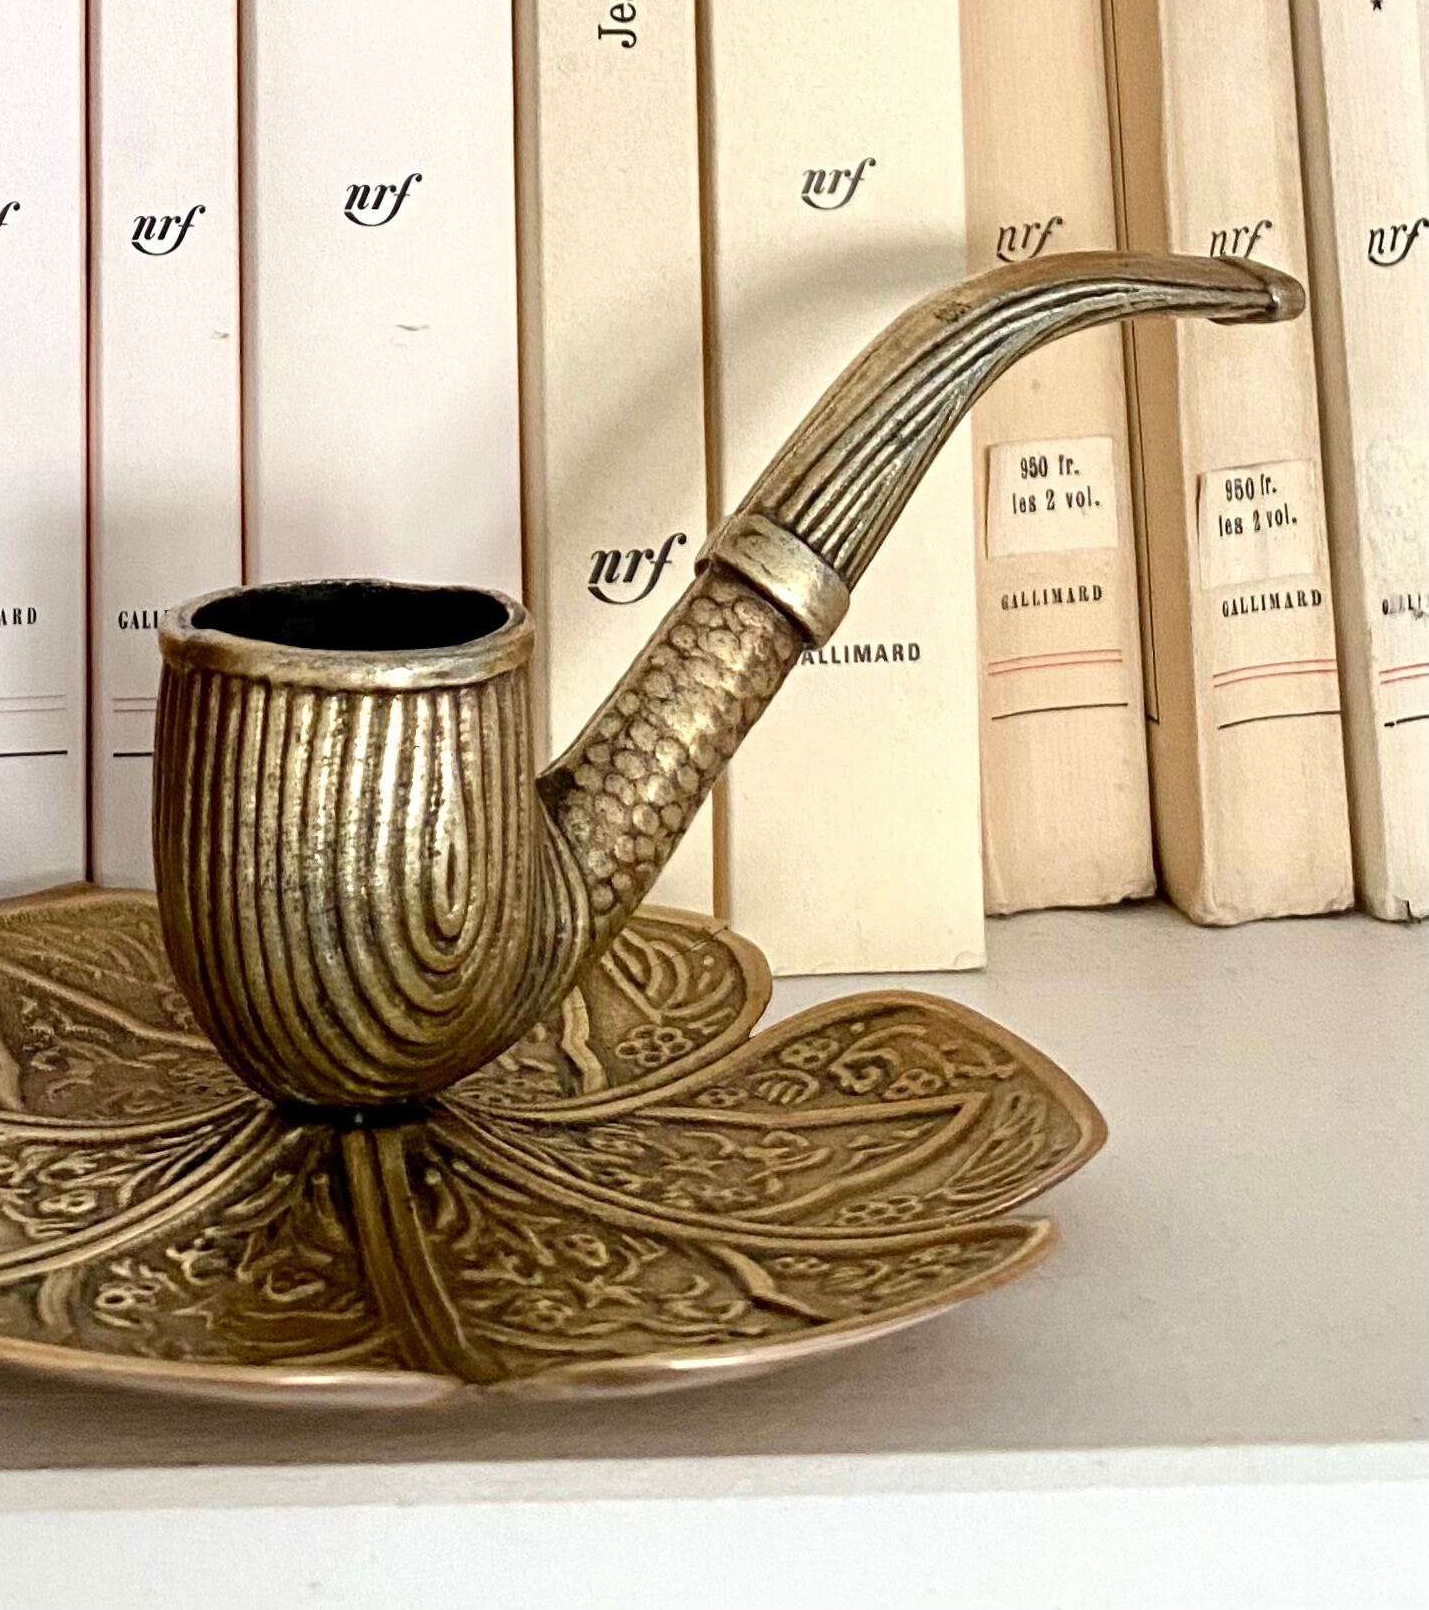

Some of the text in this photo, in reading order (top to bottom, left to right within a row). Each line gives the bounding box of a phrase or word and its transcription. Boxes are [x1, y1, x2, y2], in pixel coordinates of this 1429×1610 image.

[341, 171, 424, 228] nrf
[800, 156, 877, 211] nrf
[130, 202, 207, 258] nrf
[995, 215, 1065, 262] nrf
[1209, 219, 1274, 259] nrf
[1367, 216, 1429, 268] nrf
[1020, 454, 1081, 480] 950 fr.
[1260, 473, 1278, 496] fr.
[1012, 485, 1101, 516] les 2 vol.
[1218, 504, 1298, 537] les 2 vol.
[585, 530, 688, 607] nrf
[1001, 584, 1103, 612] GALLIMARD
[1221, 589, 1322, 618] GALLIMARD
[798, 640, 922, 667] ALLIMARD
